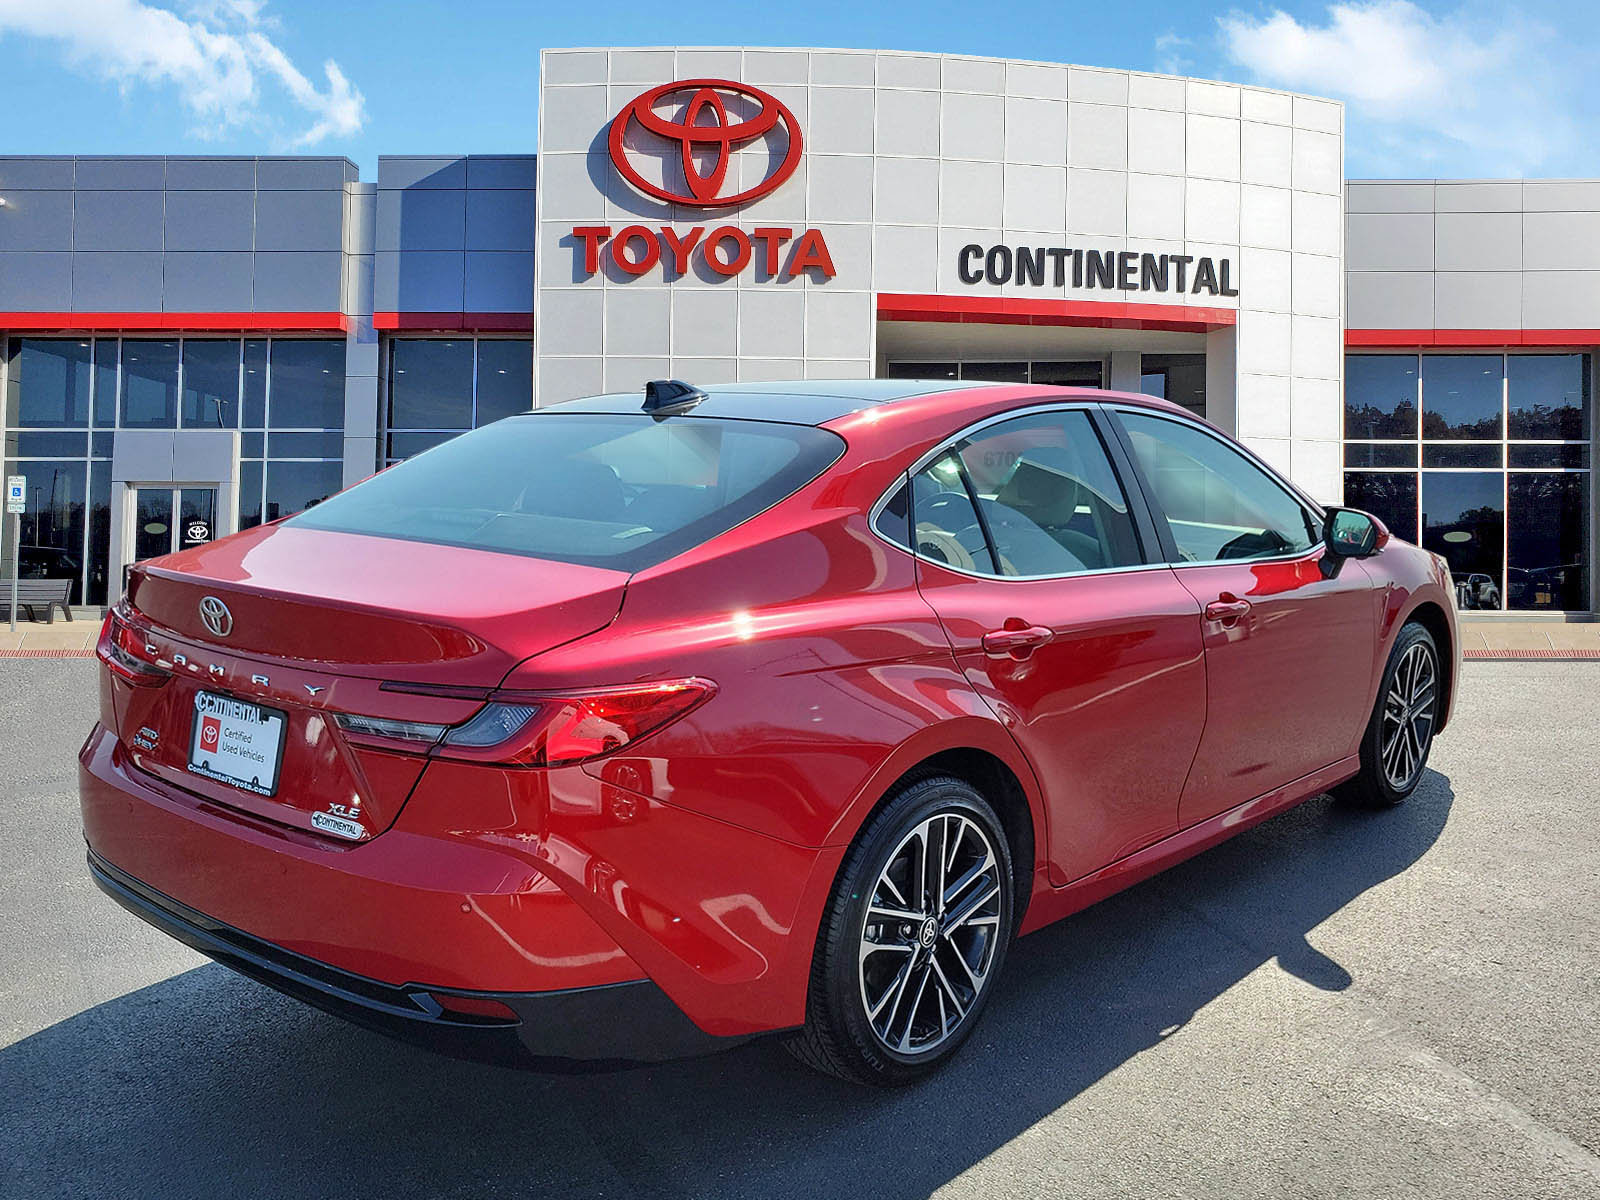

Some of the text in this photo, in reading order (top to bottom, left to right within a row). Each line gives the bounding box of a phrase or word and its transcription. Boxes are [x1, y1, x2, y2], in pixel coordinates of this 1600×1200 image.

[573, 226, 836, 277] TOYOTA
[958, 244, 1239, 296] CONTINENTAL
[145, 644, 325, 697] CAMRY
[196, 692, 263, 725] CONTINENTAL
[222, 740, 265, 763] Used Vehicles
[224, 728, 253, 744] Certified
[187, 763, 271, 796] ContinentalToyota.com
[314, 814, 357, 835] CONTINENTAL
[326, 802, 361, 819] XLE
